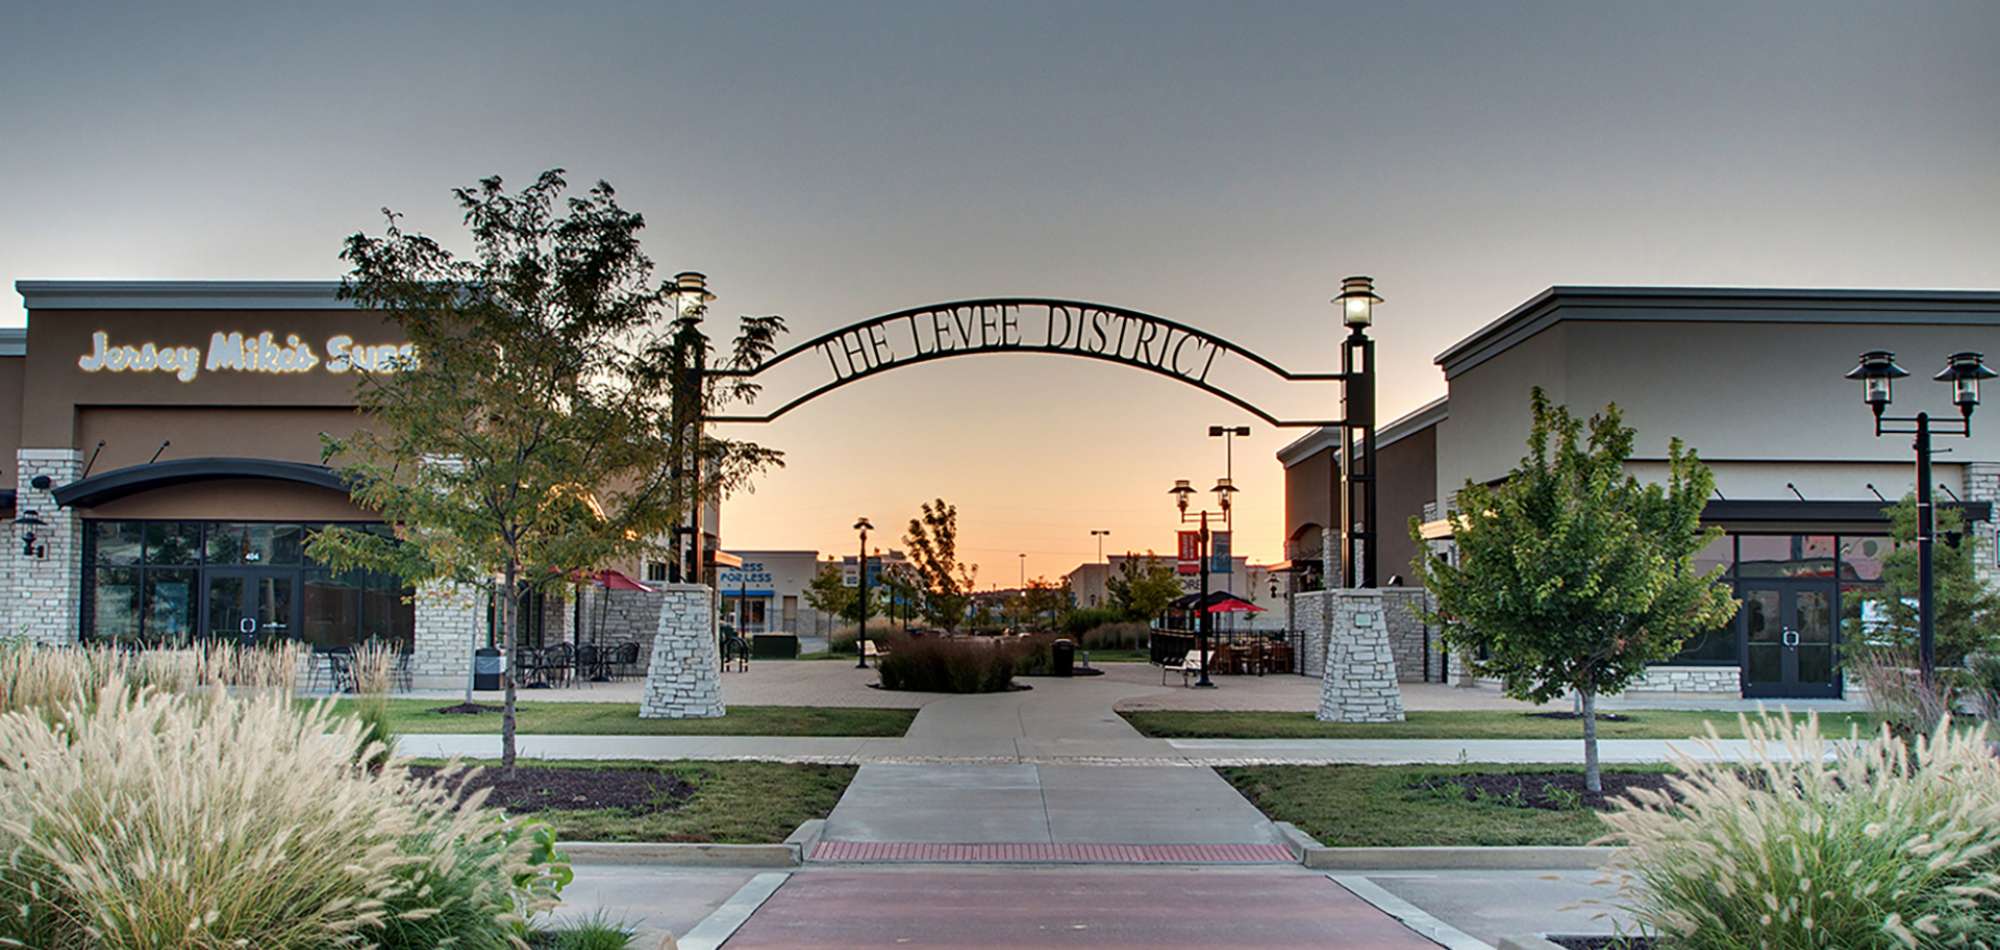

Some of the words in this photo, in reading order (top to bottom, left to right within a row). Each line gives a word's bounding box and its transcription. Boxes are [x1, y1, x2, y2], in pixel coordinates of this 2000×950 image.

[79, 330, 200, 382] Jersey
[204, 331, 319, 372] Mike's
[814, 321, 896, 382] THE
[908, 302, 1023, 358] LEVEE
[1045, 303, 1227, 382] DISTRICT
[720, 572, 742, 582] FOR
[744, 572, 772, 582] LESS
